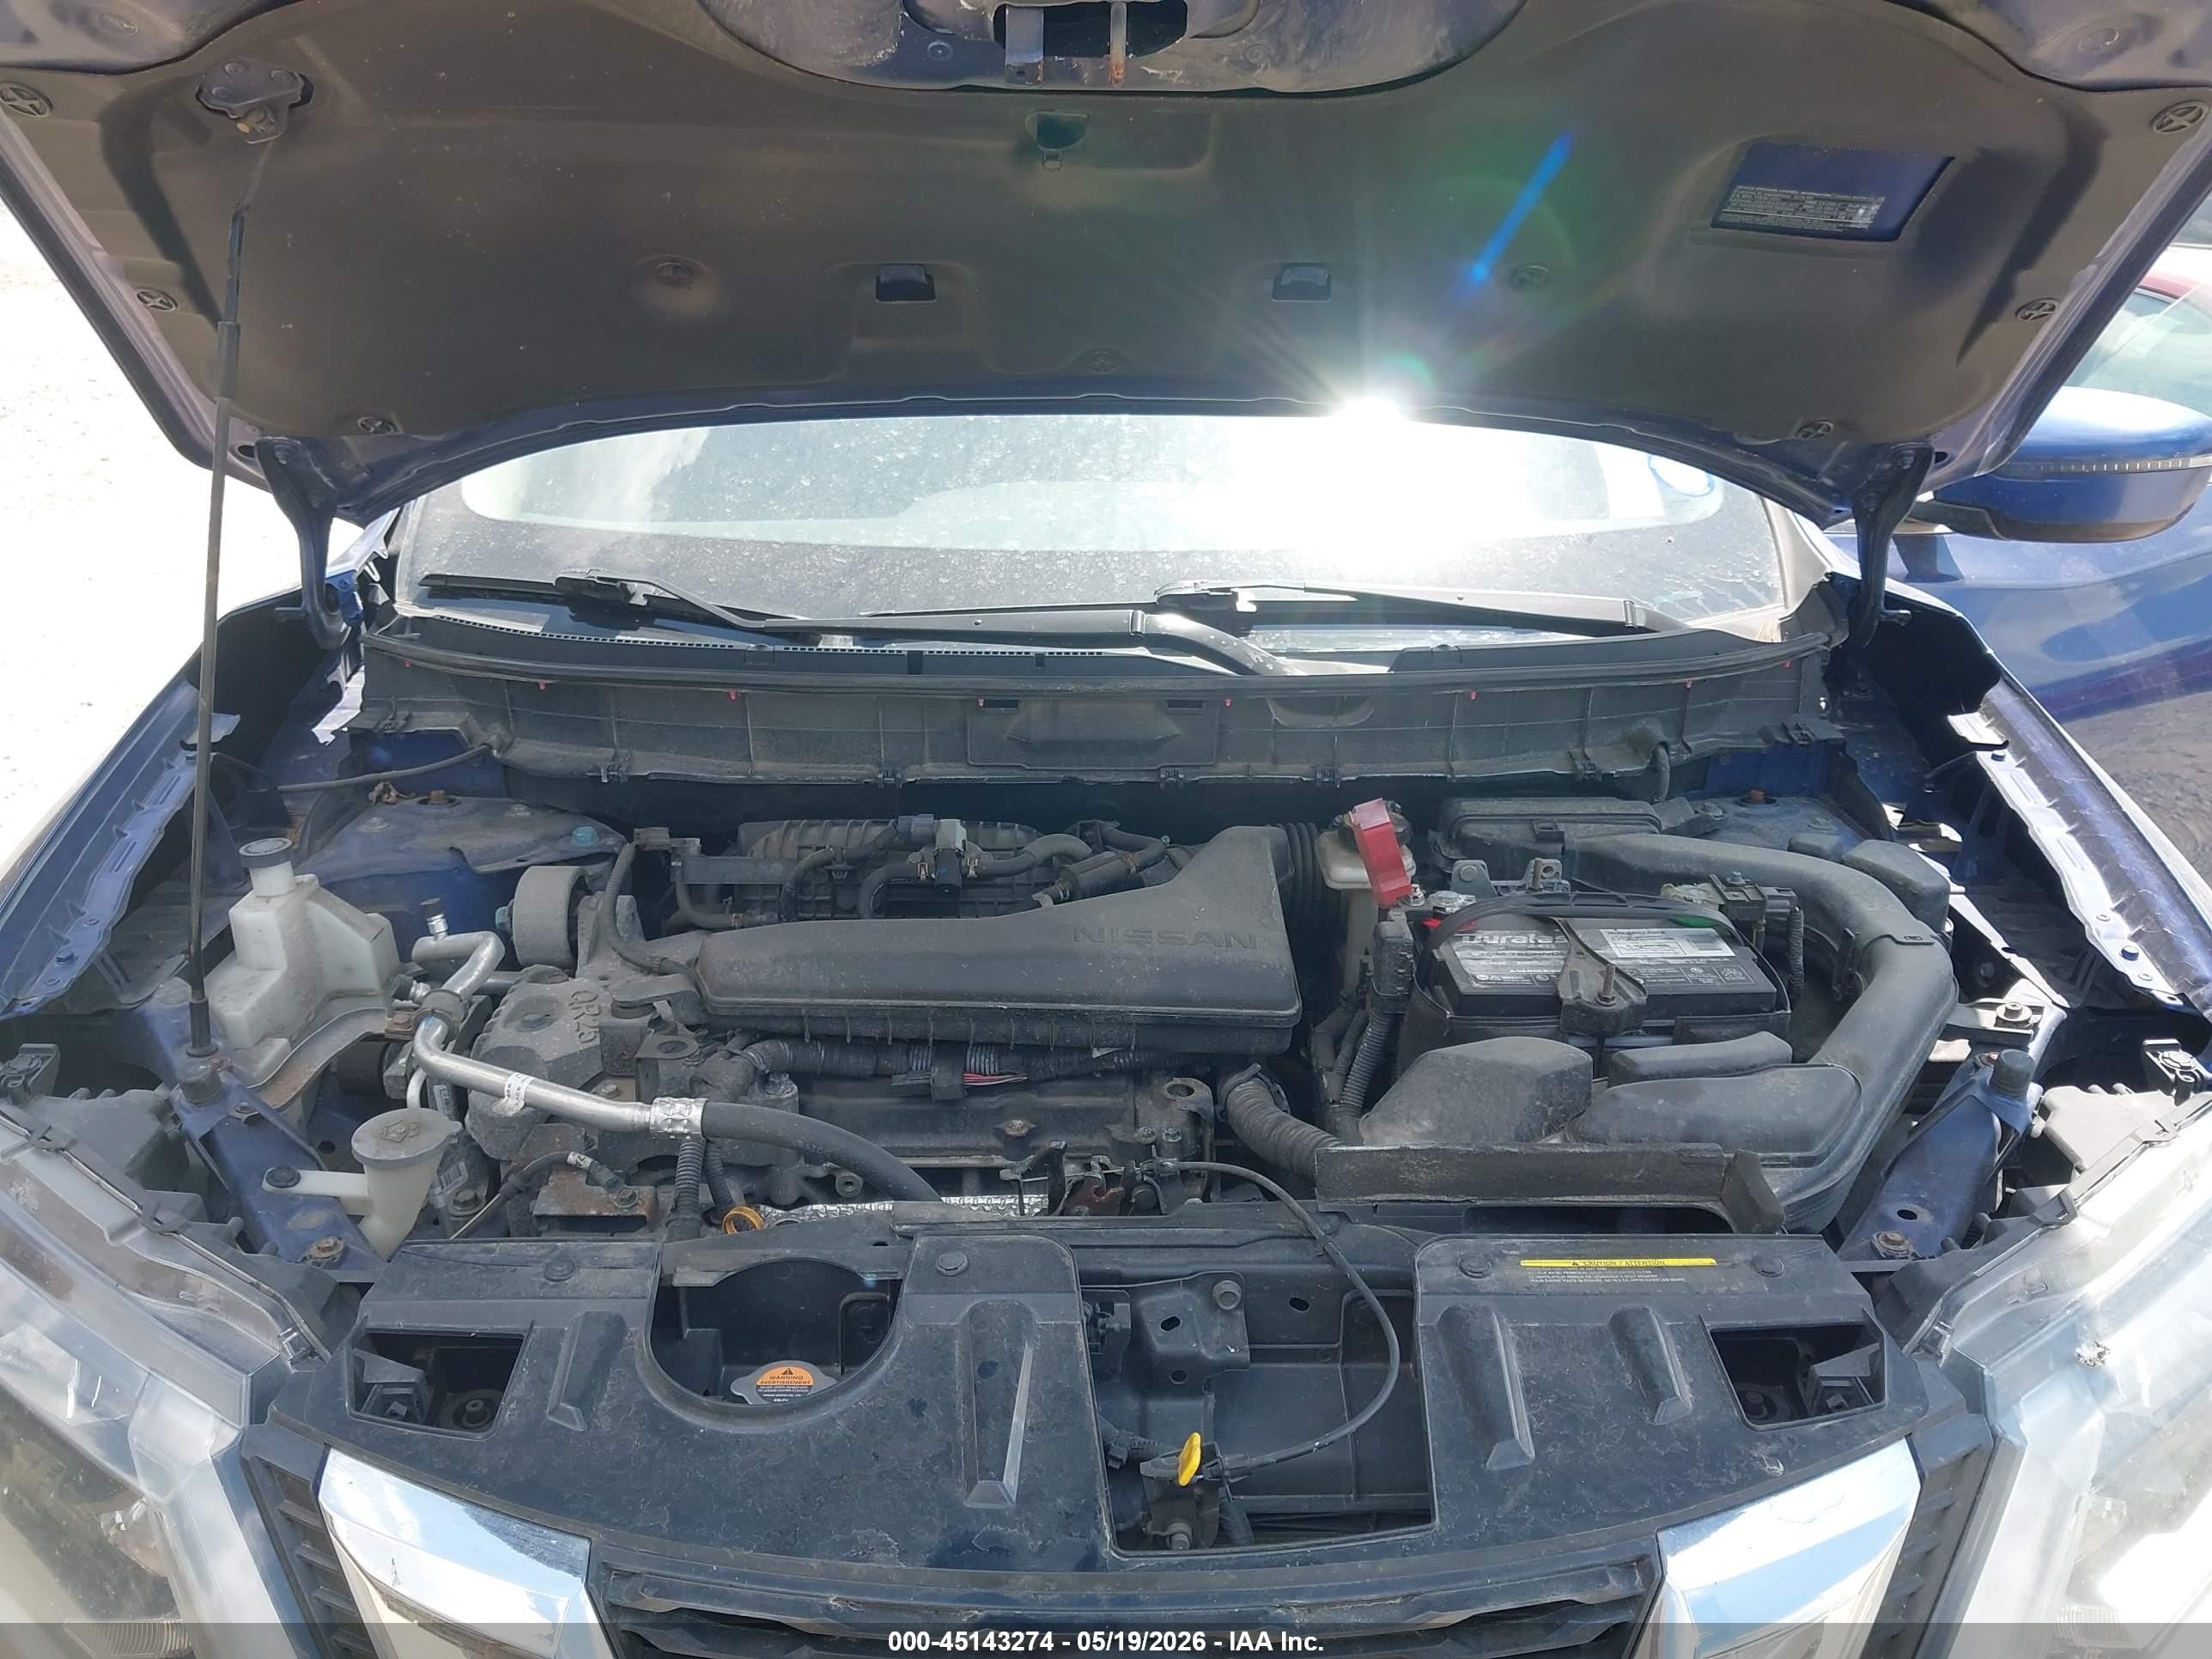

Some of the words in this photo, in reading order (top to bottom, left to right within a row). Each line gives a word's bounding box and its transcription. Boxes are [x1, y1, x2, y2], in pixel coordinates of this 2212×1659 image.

[1073, 926, 1258, 950] NISSAN
[1462, 933, 1569, 945] Duralas
[568, 988, 601, 1045] QR25
